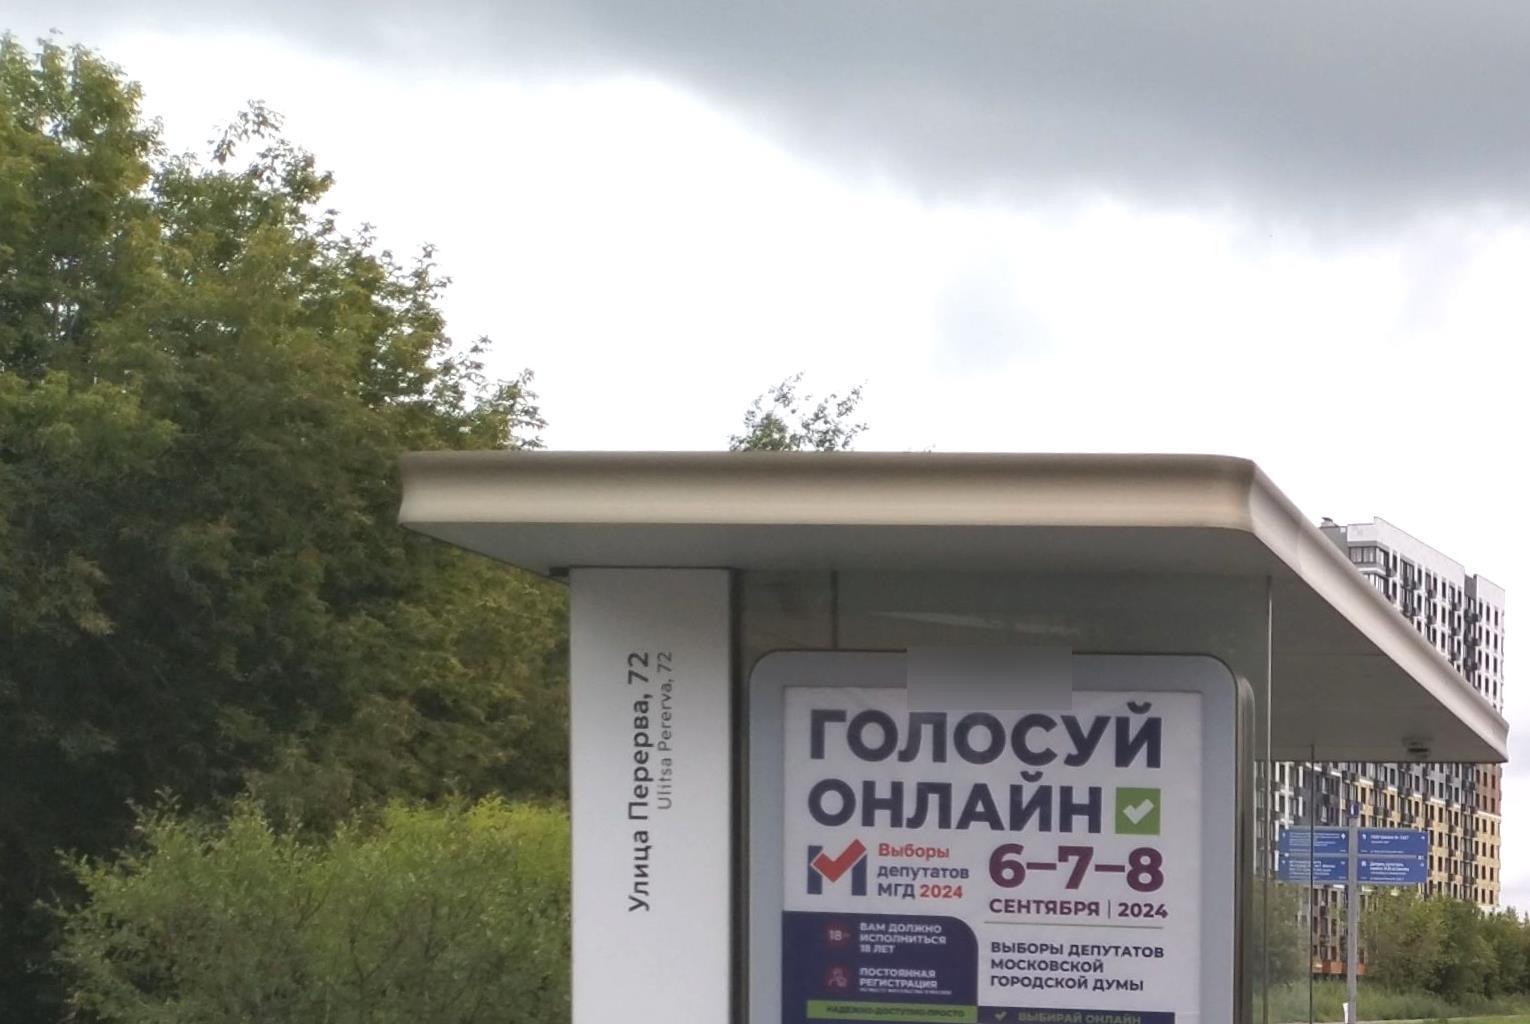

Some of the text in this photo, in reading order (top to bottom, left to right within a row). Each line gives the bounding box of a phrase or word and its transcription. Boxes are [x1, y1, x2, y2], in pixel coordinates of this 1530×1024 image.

[657, 652, 675, 810] Ulitsa Pererva, 72
[810, 701, 1162, 768] ГОЛОСУЙ
[628, 652, 653, 912] Улица Перерва, 72
[807, 771, 1101, 833] ОНЛАЙН
[878, 843, 950, 859] Выборы
[877, 864, 969, 880] депутатов
[877, 882, 963, 898] МГД 2024
[989, 899, 1168, 918] СЕНТЯБРЯ 2024
[860, 923, 941, 933] ВАМ ДОЛЖНО
[860, 934, 946, 944] ИСПОЛНИТЬСЯ
[873, 945, 895, 953] ЛЕТ
[991, 942, 1164, 958] ВЫБОРЫ ДЕПУТАТОВ
[860, 968, 935, 978] ПОСТОЯННАЯ
[991, 958, 1103, 973] МОСКОВСКОЙ
[860, 979, 938, 989] РЕГИСТРАЦИЯ
[990, 974, 1143, 991] ГОРОДСКОЙ ДУМЫ
[1019, 1011, 1141, 1024] ВЫБИРАЙ ОНЛАЙН
